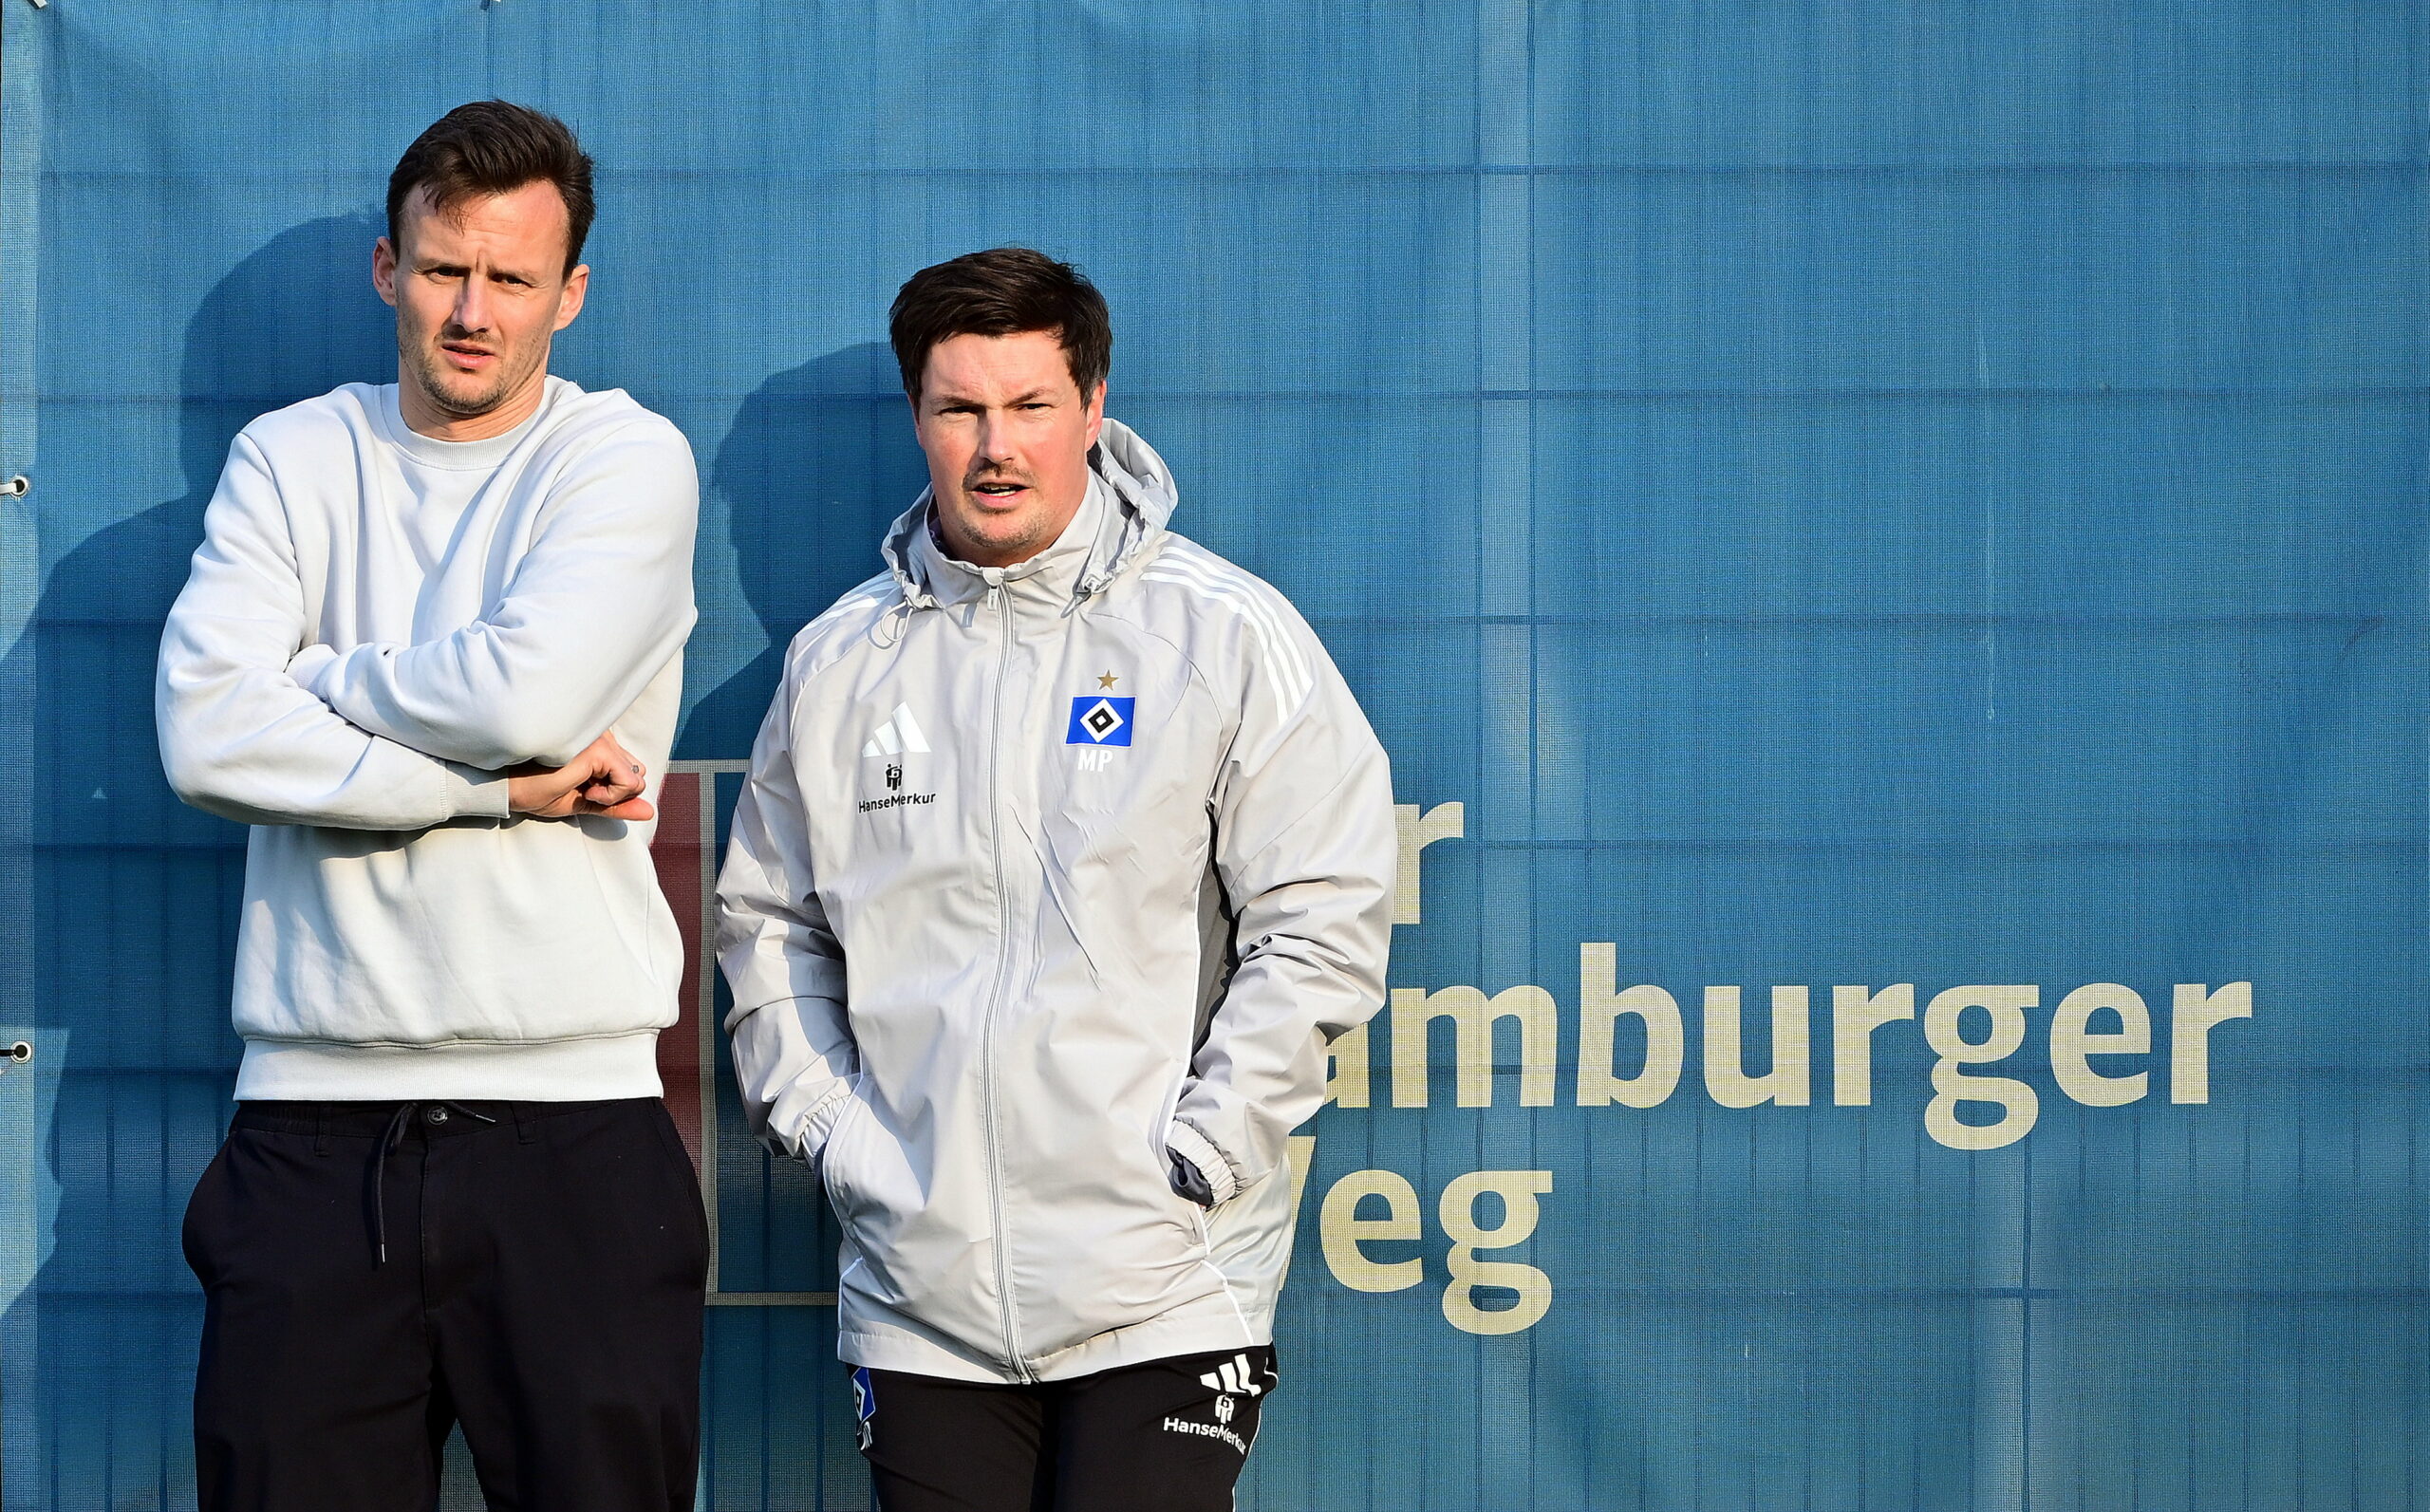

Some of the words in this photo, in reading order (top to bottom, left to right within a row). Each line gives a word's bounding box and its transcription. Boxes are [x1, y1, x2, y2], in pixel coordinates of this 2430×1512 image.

[1077, 748, 1114, 773] MP
[857, 791, 937, 814] HanseMerkur
[1278, 1135, 1554, 1335] eg
[1163, 1416, 1247, 1456] HanseMerkur
